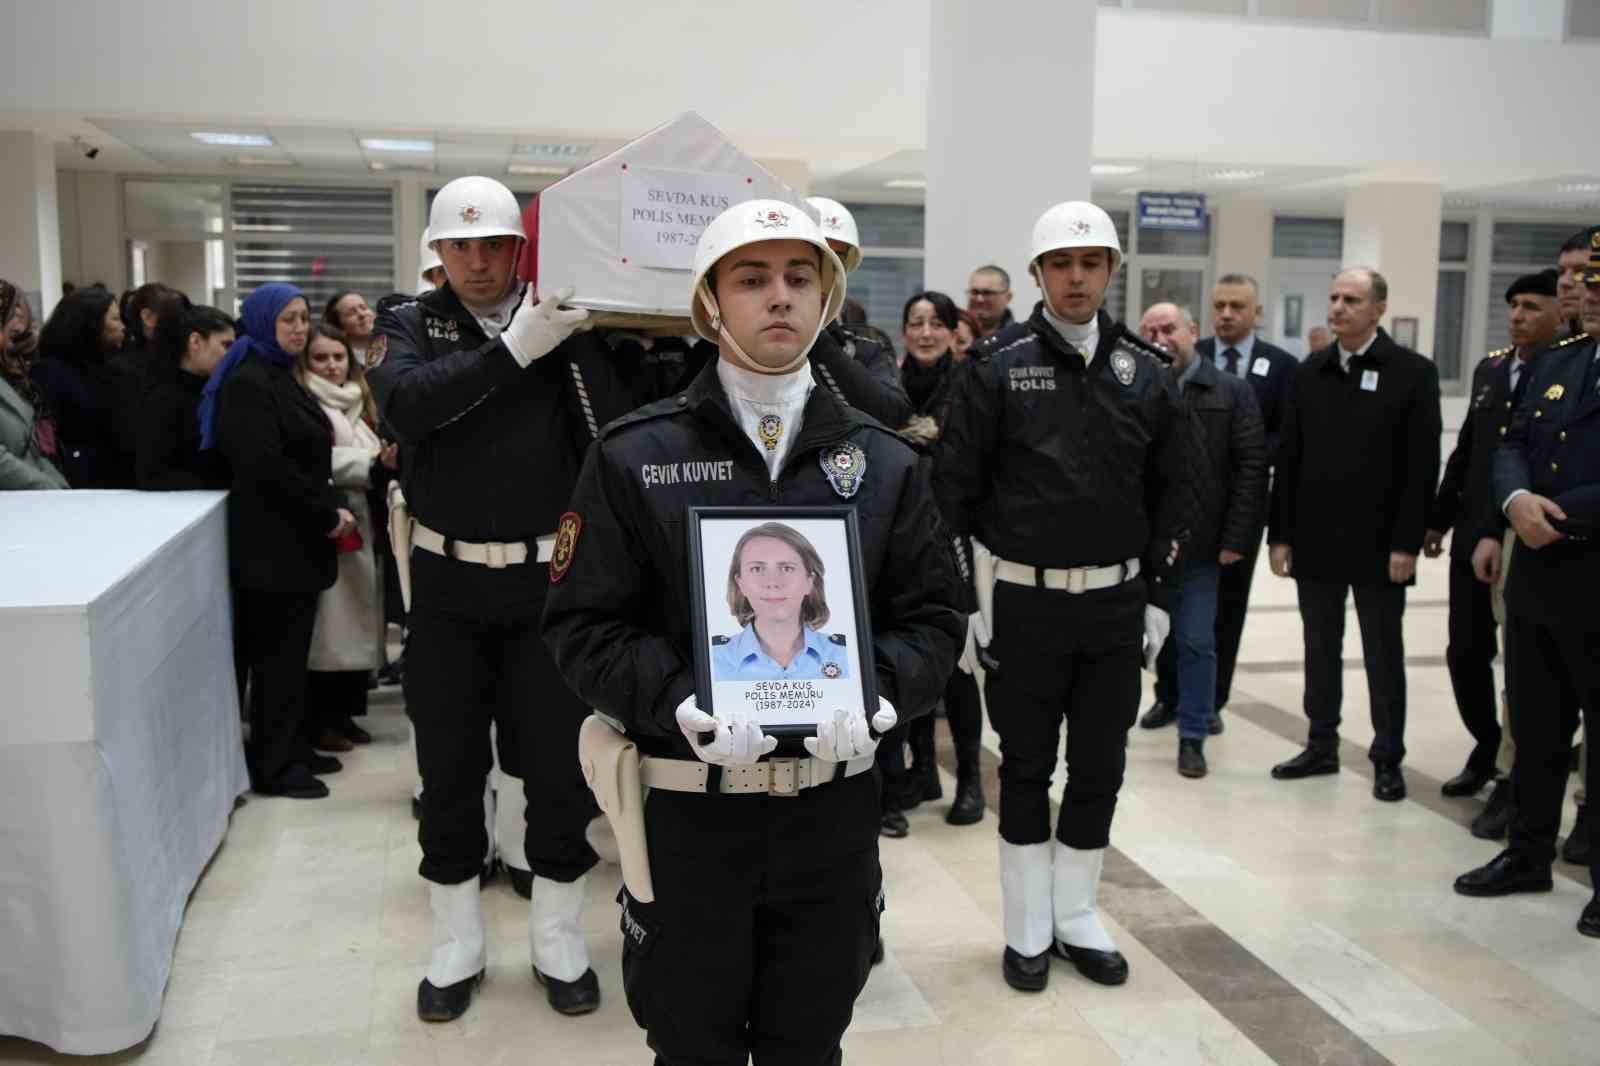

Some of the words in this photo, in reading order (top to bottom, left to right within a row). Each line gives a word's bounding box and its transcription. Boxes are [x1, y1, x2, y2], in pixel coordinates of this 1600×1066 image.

[647, 190, 697, 206] SEVDA
[676, 212, 717, 227] MEM
[682, 460, 734, 482] KUVVET
[755, 682, 789, 691] SEVDA
[780, 690, 824, 700] MEMURU
[755, 699, 815, 711] (1987-2024)
